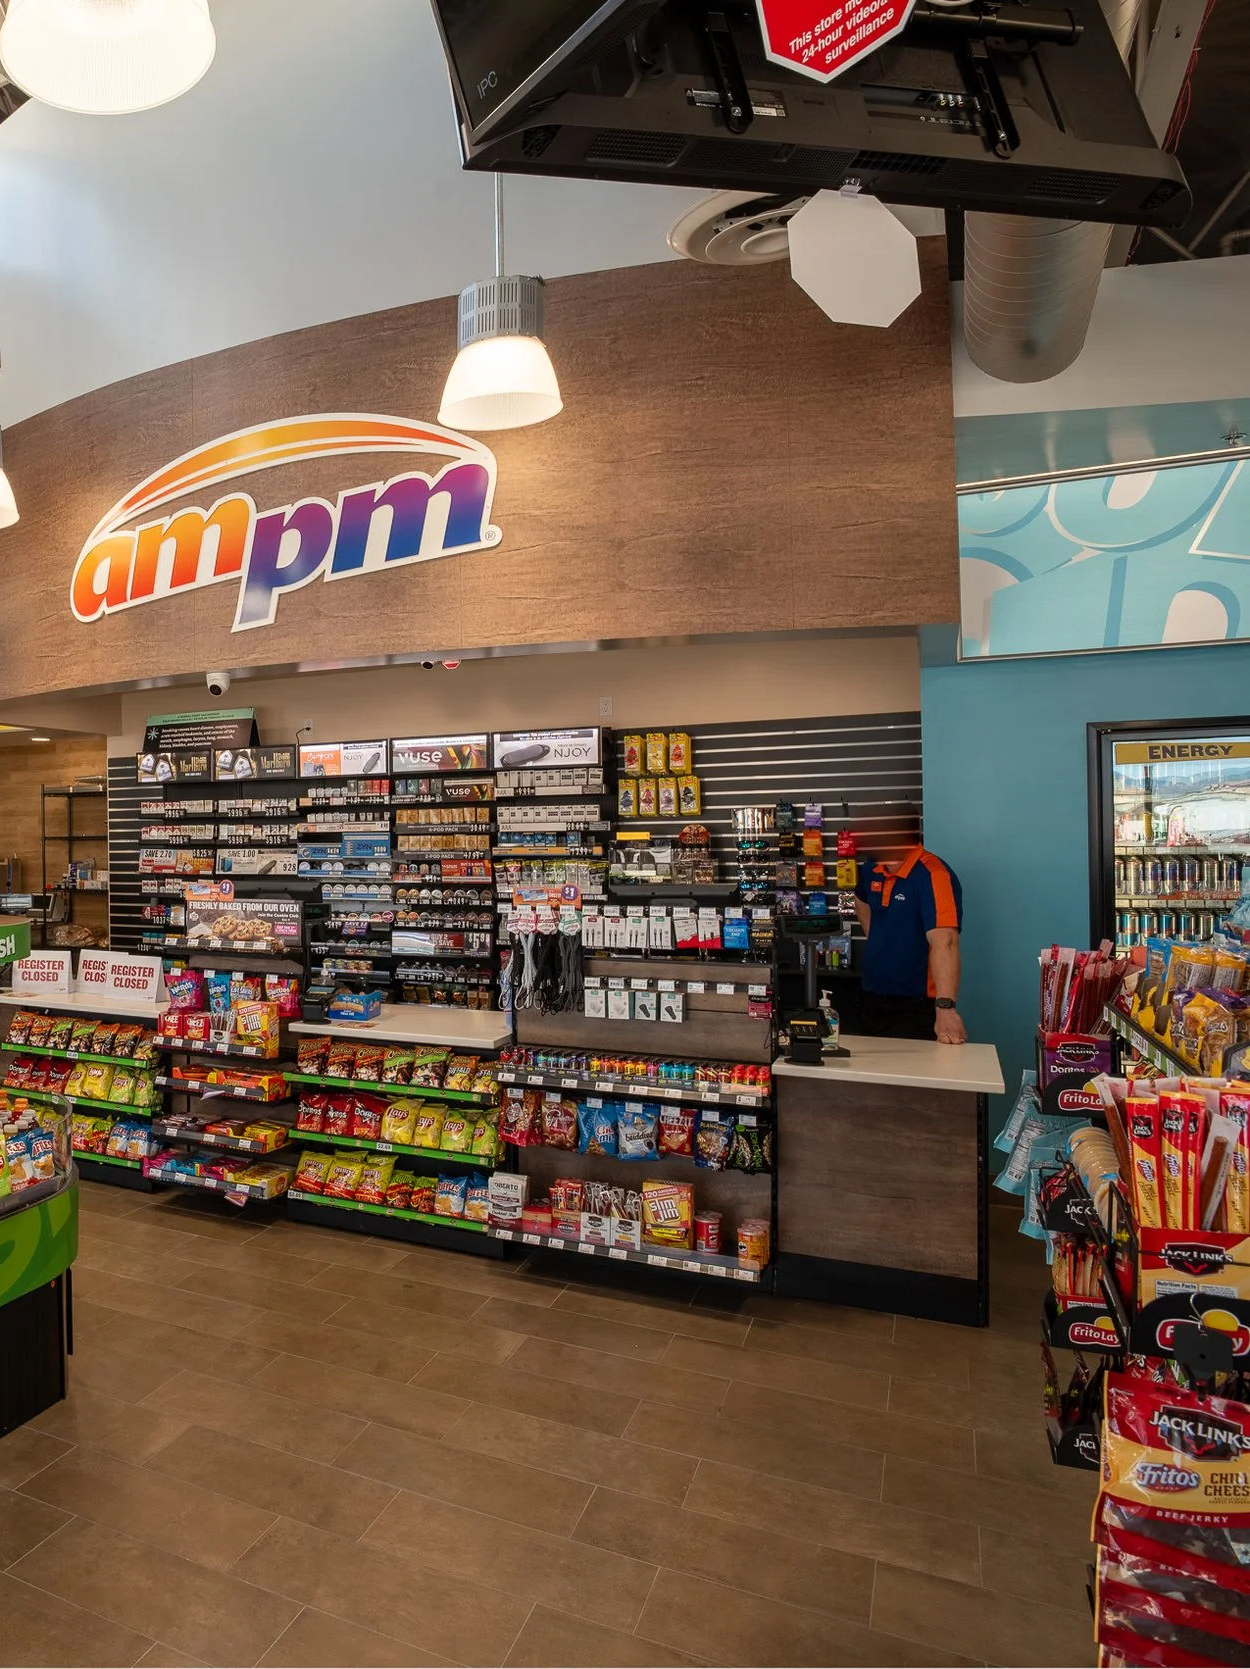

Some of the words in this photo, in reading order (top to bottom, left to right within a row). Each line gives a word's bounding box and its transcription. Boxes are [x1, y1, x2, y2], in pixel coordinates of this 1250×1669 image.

[789, 31, 813, 54] This
[814, 8, 843, 36] store
[825, 7, 895, 64] surveillance
[802, 25, 844, 64] 24-hour
[477, 70, 498, 100] IPC
[71, 458, 492, 630] ampm
[554, 747, 591, 758] NJOY
[1147, 744, 1234, 761] ENERGY
[144, 850, 158, 858] SAVE
[565, 887, 575, 897] $1
[189, 901, 218, 910] FRESHLY
[219, 902, 242, 911] BAKED
[243, 903, 263, 912] FROM
[264, 903, 279, 912] OUR
[280, 904, 300, 913] OVEN
[18, 959, 65, 970] REGISTER
[82, 959, 109, 970] REGIS
[21, 970, 59, 982] CLOSED
[84, 971, 107, 983] CLOS
[111, 964, 155, 979] REGISTER
[113, 977, 149, 990] CLOSED
[1050, 1065, 1085, 1074] Doritos
[387, 1108, 410, 1120] Lay's
[644, 1191, 658, 1199] 120
[1157, 1281, 1180, 1289] Nutrition
[1181, 1282, 1197, 1290] Facts
[1149, 1411, 1196, 1436] JACK
[1197, 1422, 1250, 1450] LINK'S
[1074, 1438, 1096, 1450] JAC
[1136, 1461, 1200, 1487] Fritos
[1156, 1510, 1186, 1521] BEEF
[1188, 1511, 1229, 1523] JERKY
